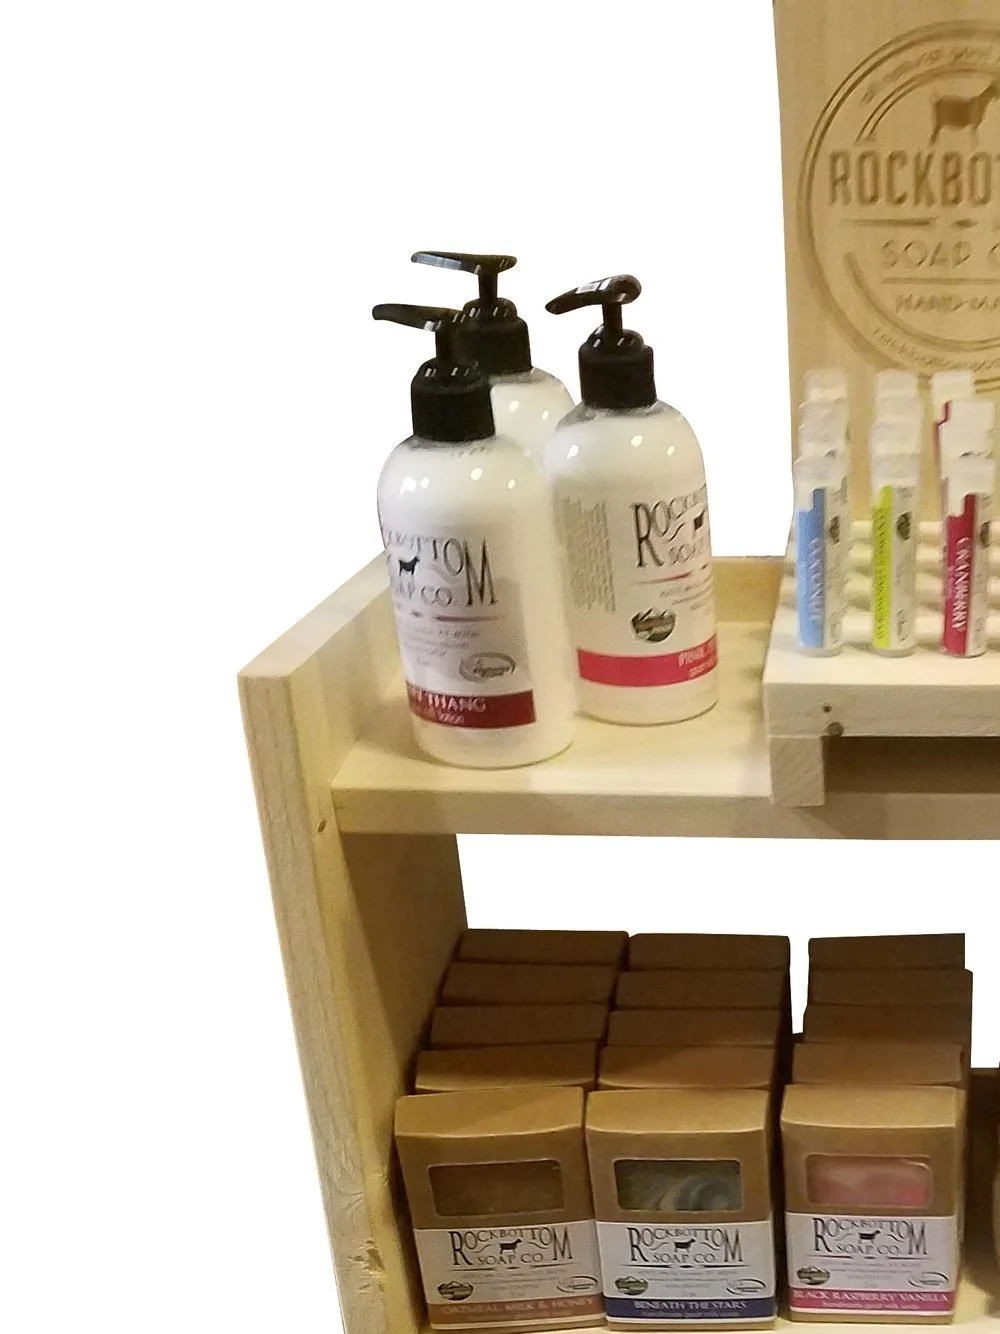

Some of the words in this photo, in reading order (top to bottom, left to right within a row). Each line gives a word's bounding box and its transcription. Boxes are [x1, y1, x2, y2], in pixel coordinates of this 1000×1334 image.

[881, 240, 972, 269] SOAP
[813, 1217, 928, 1256] ROCKBOTTOM
[447, 1225, 574, 1266] ROCKBOTTOM
[626, 1227, 744, 1263] ROCKBOTTOM
[836, 1243, 873, 1255] SOAP
[477, 1253, 516, 1266] SOAP
[653, 1253, 690, 1264] SOAP
[792, 1289, 830, 1300] BLACK
[832, 1290, 896, 1301] RASPBERRY
[899, 1292, 949, 1303] VANILLA
[633, 1300, 685, 1310] BENEATH
